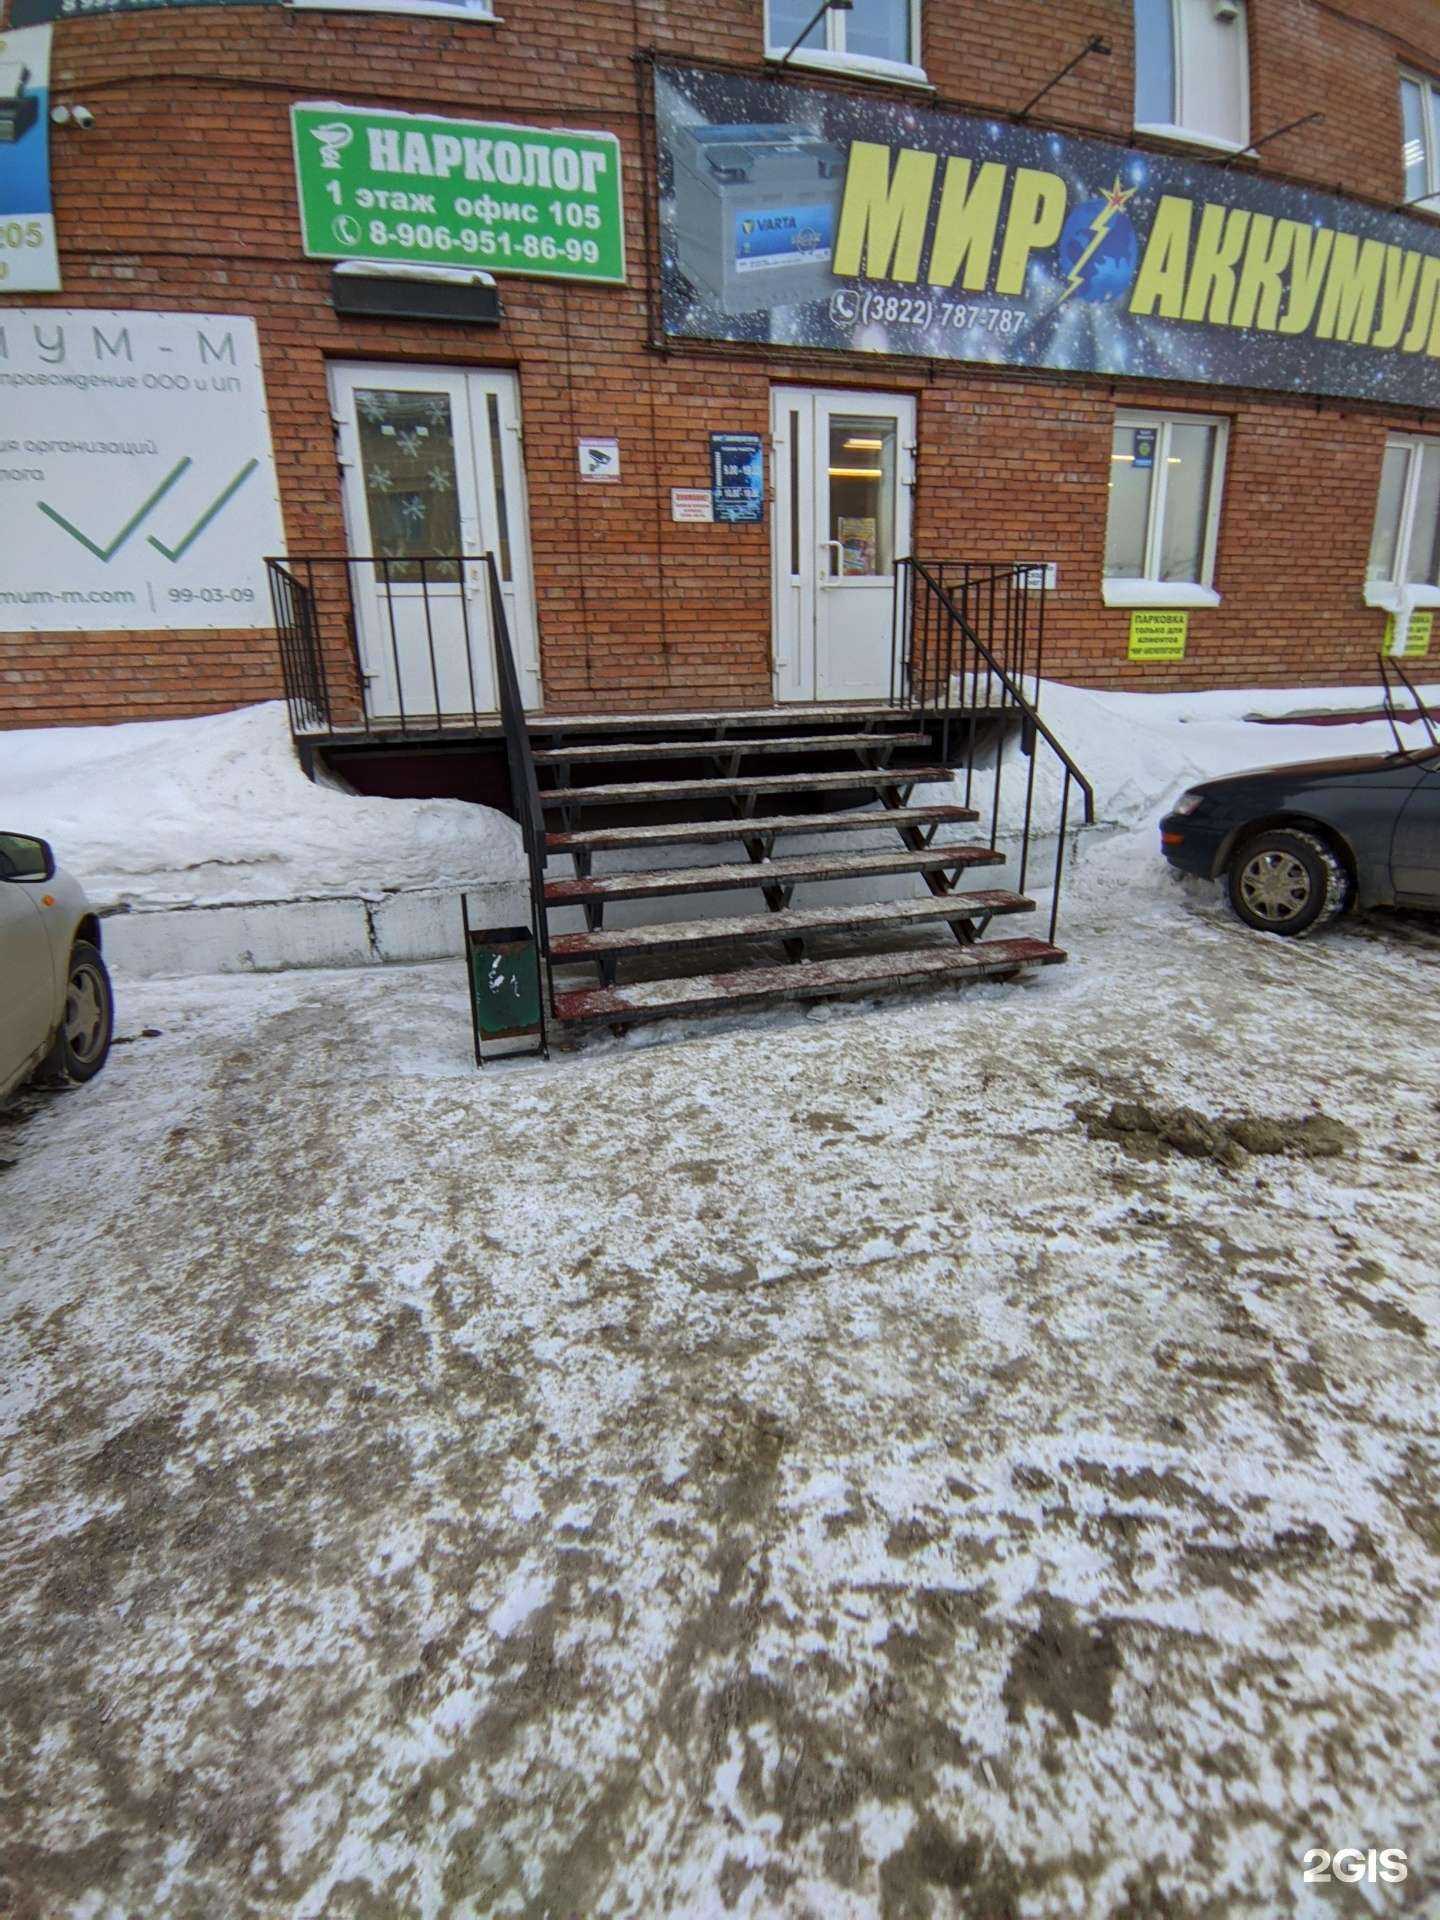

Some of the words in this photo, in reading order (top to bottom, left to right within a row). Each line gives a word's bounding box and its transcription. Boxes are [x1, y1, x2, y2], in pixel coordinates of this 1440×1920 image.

[366, 127, 606, 194] НАРКОЛОГ
[325, 179, 342, 205] 1
[355, 187, 437, 214] этаж
[454, 194, 539, 225] офис
[549, 201, 602, 230] 105
[756, 216, 797, 232] VARTA
[833, 139, 1067, 296] МИР
[368, 220, 600, 264] 8-906-951-86-99
[862, 295, 933, 329] (3822)
[941, 303, 1026, 334] 787-787
[168, 587, 255, 604] 99-03-09
